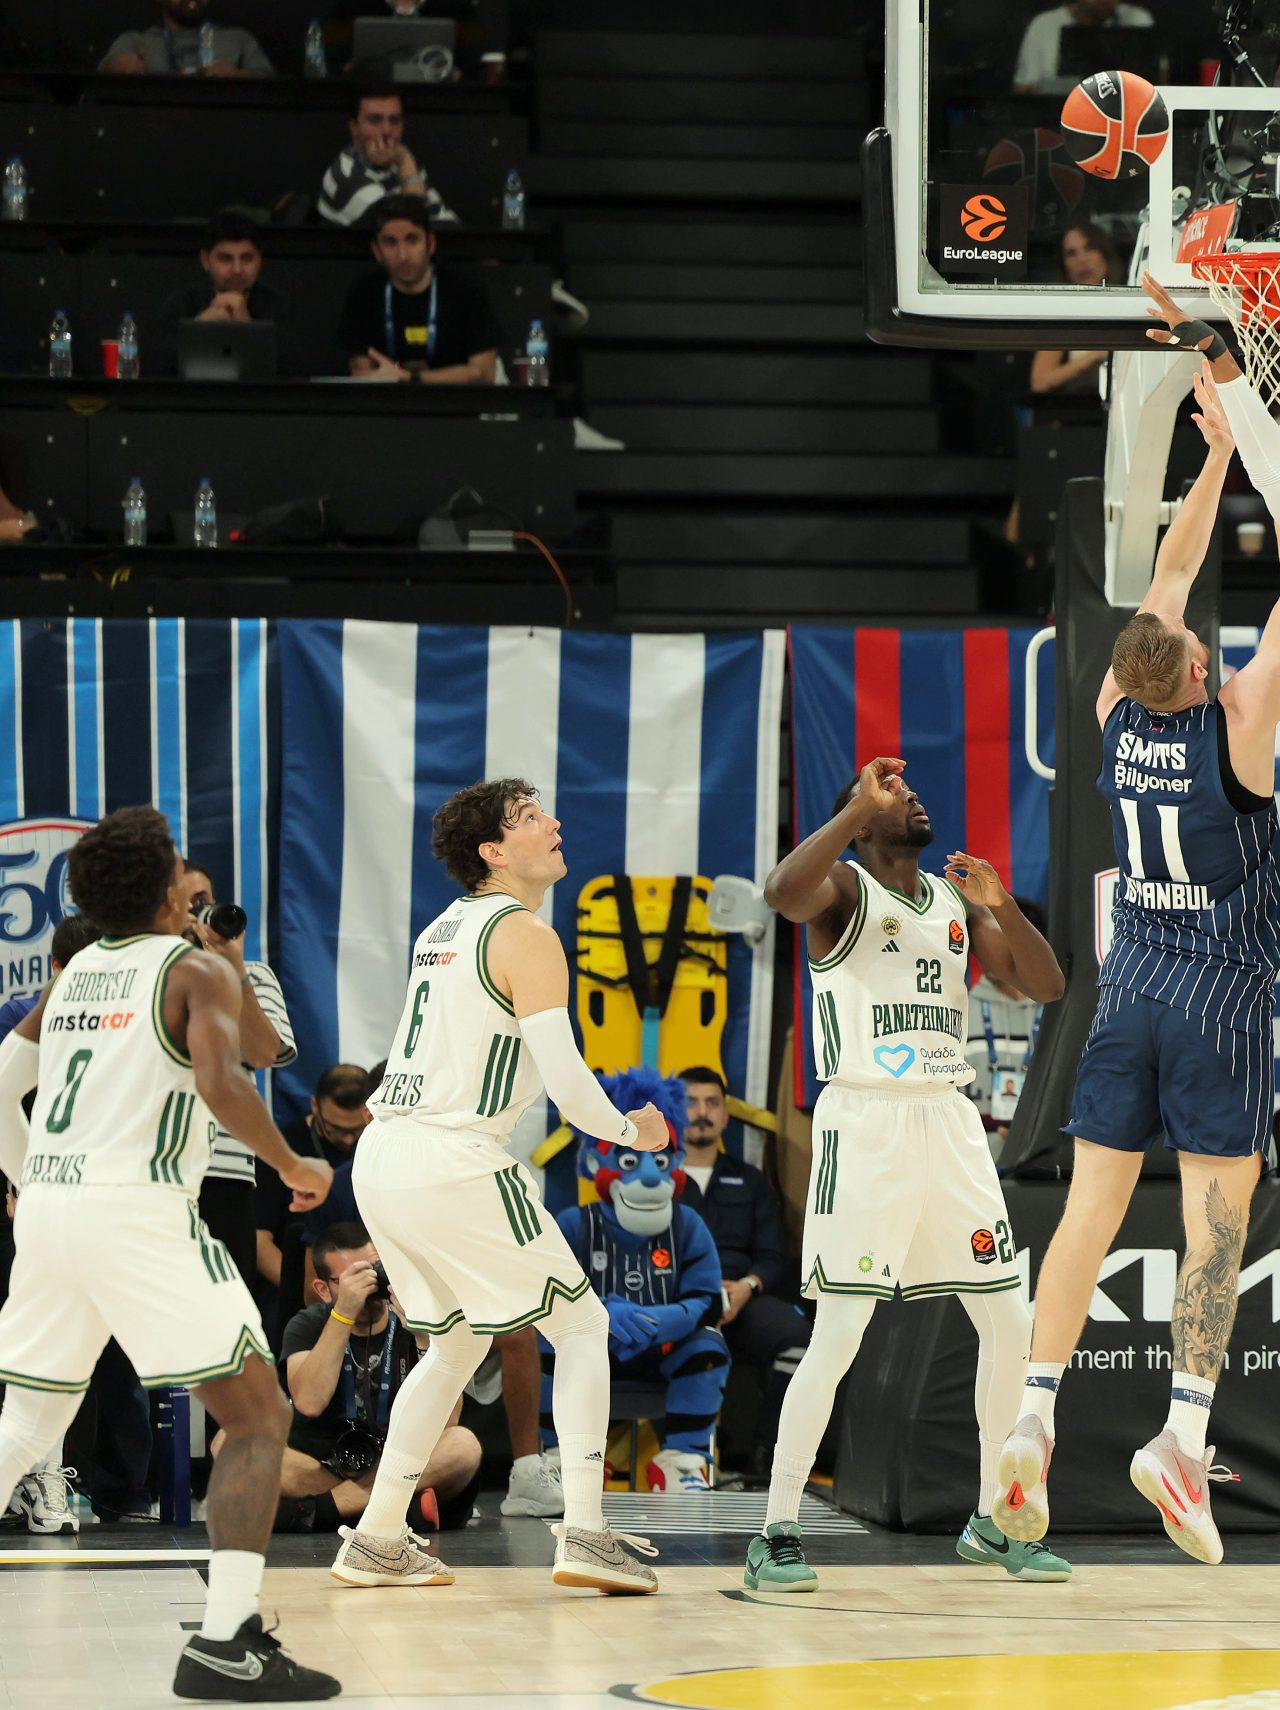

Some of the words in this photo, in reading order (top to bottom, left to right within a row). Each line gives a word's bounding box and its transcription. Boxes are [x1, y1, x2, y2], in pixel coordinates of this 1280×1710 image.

[943, 246, 1022, 263] EuroLeague
[1115, 761, 1193, 794] Bilyoner
[1119, 797, 1190, 883] 11
[63, 969, 123, 1002] SHORTS
[915, 958, 942, 994] 22
[48, 1009, 135, 1033] instacar
[404, 981, 430, 1059] 6
[45, 1049, 93, 1134] 0
